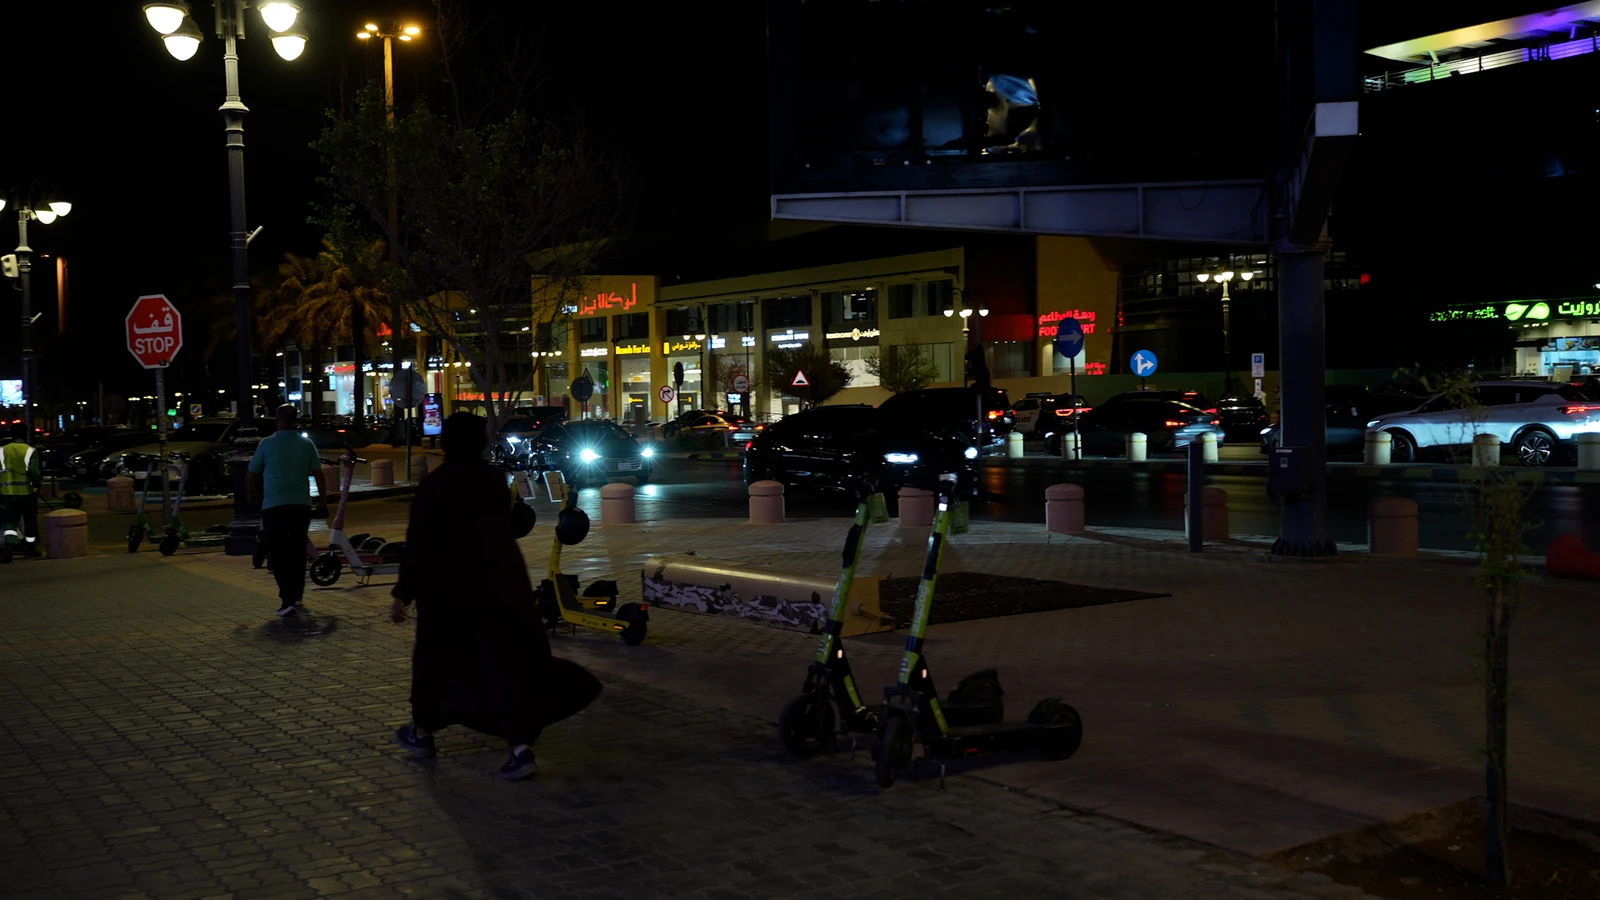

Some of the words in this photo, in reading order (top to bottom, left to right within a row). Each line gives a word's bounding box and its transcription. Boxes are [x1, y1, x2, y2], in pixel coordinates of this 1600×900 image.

[133, 306, 174, 335] قف
[1038, 326, 1059, 337] FOO
[135, 336, 175, 355] STOP
[615, 345, 633, 355] Brands
[633, 345, 642, 354] For
